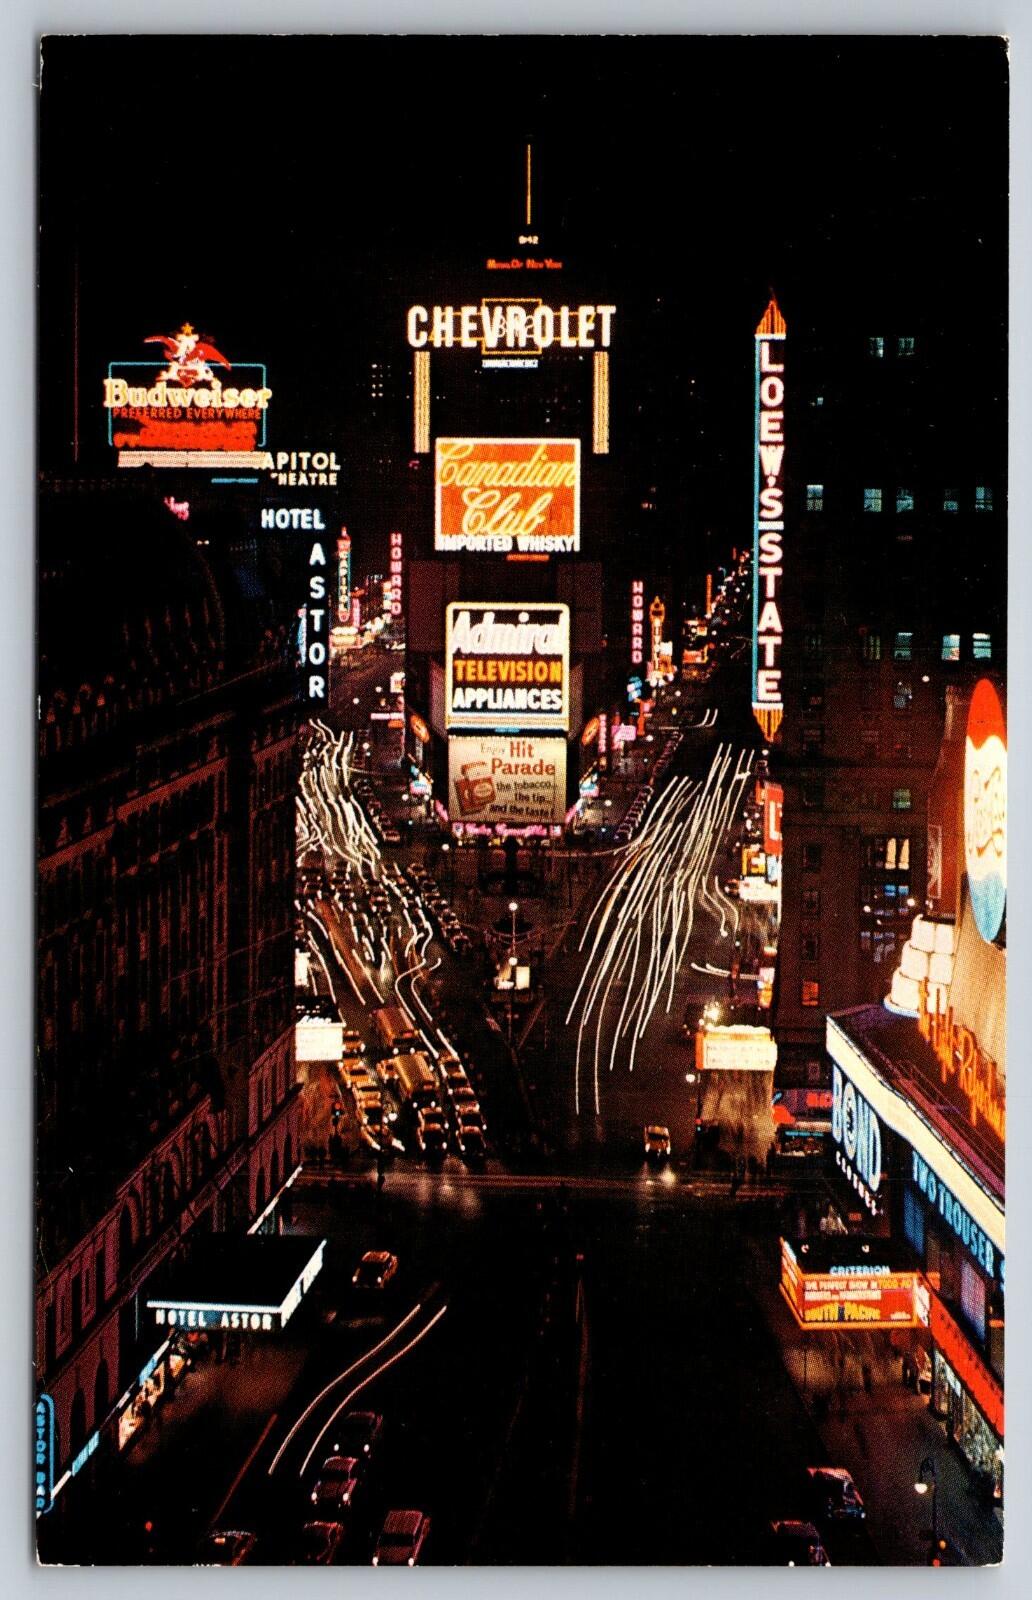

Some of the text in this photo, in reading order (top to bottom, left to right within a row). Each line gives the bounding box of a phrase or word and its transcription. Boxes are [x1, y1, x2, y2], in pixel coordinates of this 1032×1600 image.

[407, 305, 617, 348] CHEVROLET
[103, 378, 273, 409] Budweiser
[113, 407, 182, 419] PREFERRED
[759, 341, 785, 519] LOEW'S
[257, 452, 341, 470] APITOL
[438, 444, 577, 487] Canadian
[261, 509, 326, 530] HOTEL
[462, 488, 554, 536] Club
[439, 535, 575, 551] IMPORTED WHISKY
[390, 533, 403, 615] HOWARD
[308, 542, 327, 699] ASTOR
[632, 581, 644, 664] HOWARD
[757, 532, 783, 701] STATE
[451, 611, 563, 655] Admiral
[453, 659, 562, 682] TELEVISION
[452, 687, 563, 710] APPLIANCES
[510, 741, 535, 758] Hit
[491, 758, 556, 776] Parade
[496, 782, 511, 790] the
[514, 793, 530, 801] the
[490, 804, 507, 812] and
[509, 804, 524, 813] the
[832, 1064, 882, 1192] BOND
[938, 1182, 995, 1279] TROUSER
[829, 1265, 892, 1276] CRITERION
[155, 1309, 273, 1331] HOTEL ASTOR
